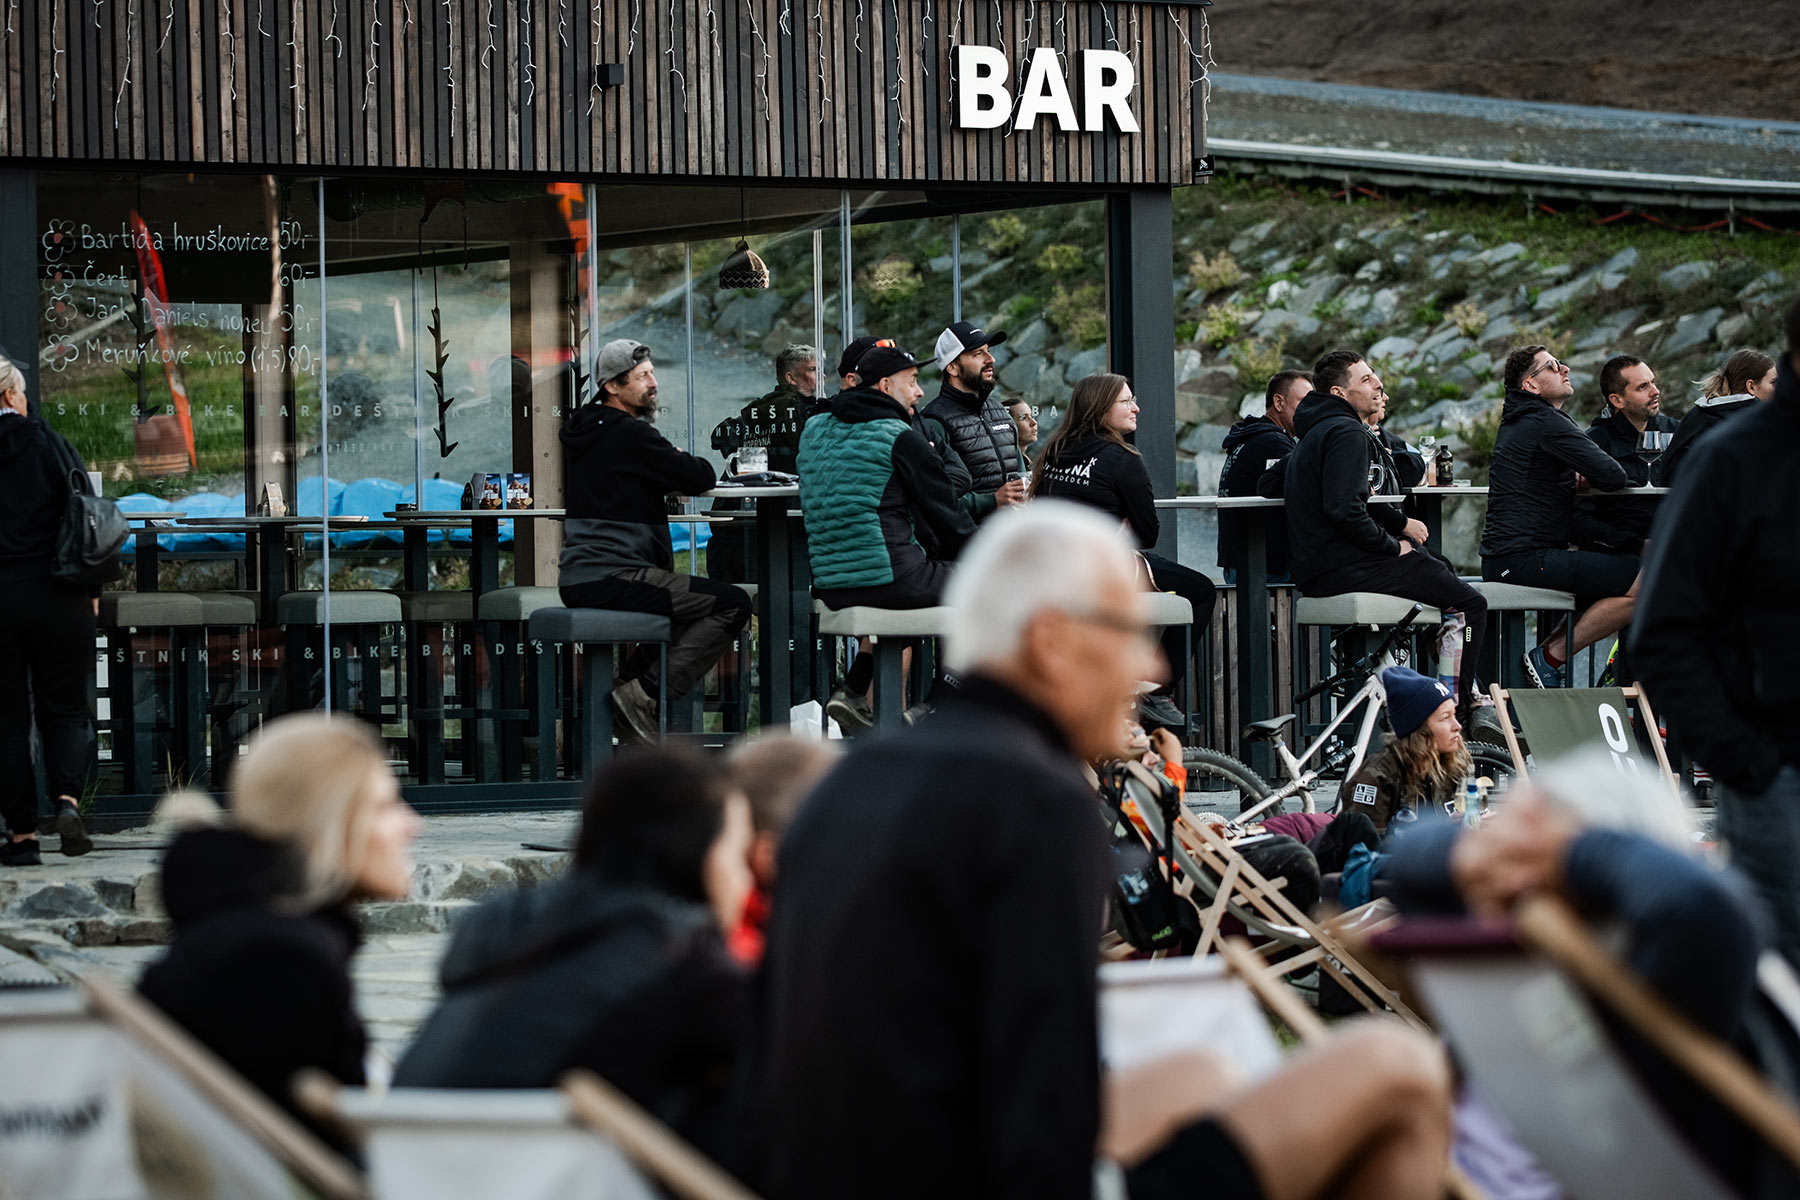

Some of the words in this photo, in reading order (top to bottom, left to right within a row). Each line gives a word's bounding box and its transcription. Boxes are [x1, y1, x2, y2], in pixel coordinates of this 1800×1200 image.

[958, 45, 1141, 133] BAR
[81, 222, 165, 251] Bartida
[174, 222, 270, 252] hruškovice
[84, 260, 129, 288] Čert
[86, 297, 130, 321] Jack
[141, 298, 209, 328] Daniels
[86, 338, 193, 365] Meruňkové
[206, 344, 246, 367] víno
[57, 404, 105, 416] SKI
[130, 404, 141, 416] &
[166, 405, 235, 417] BIKE
[259, 405, 310, 417] BAR
[551, 405, 562, 417] &
[96, 647, 208, 662] EŠTNÍK
[232, 648, 279, 661] SKI
[304, 647, 315, 659] &
[332, 646, 399, 660] BIKE
[422, 643, 472, 656] BAR
[496, 641, 584, 656] DEŠTN
